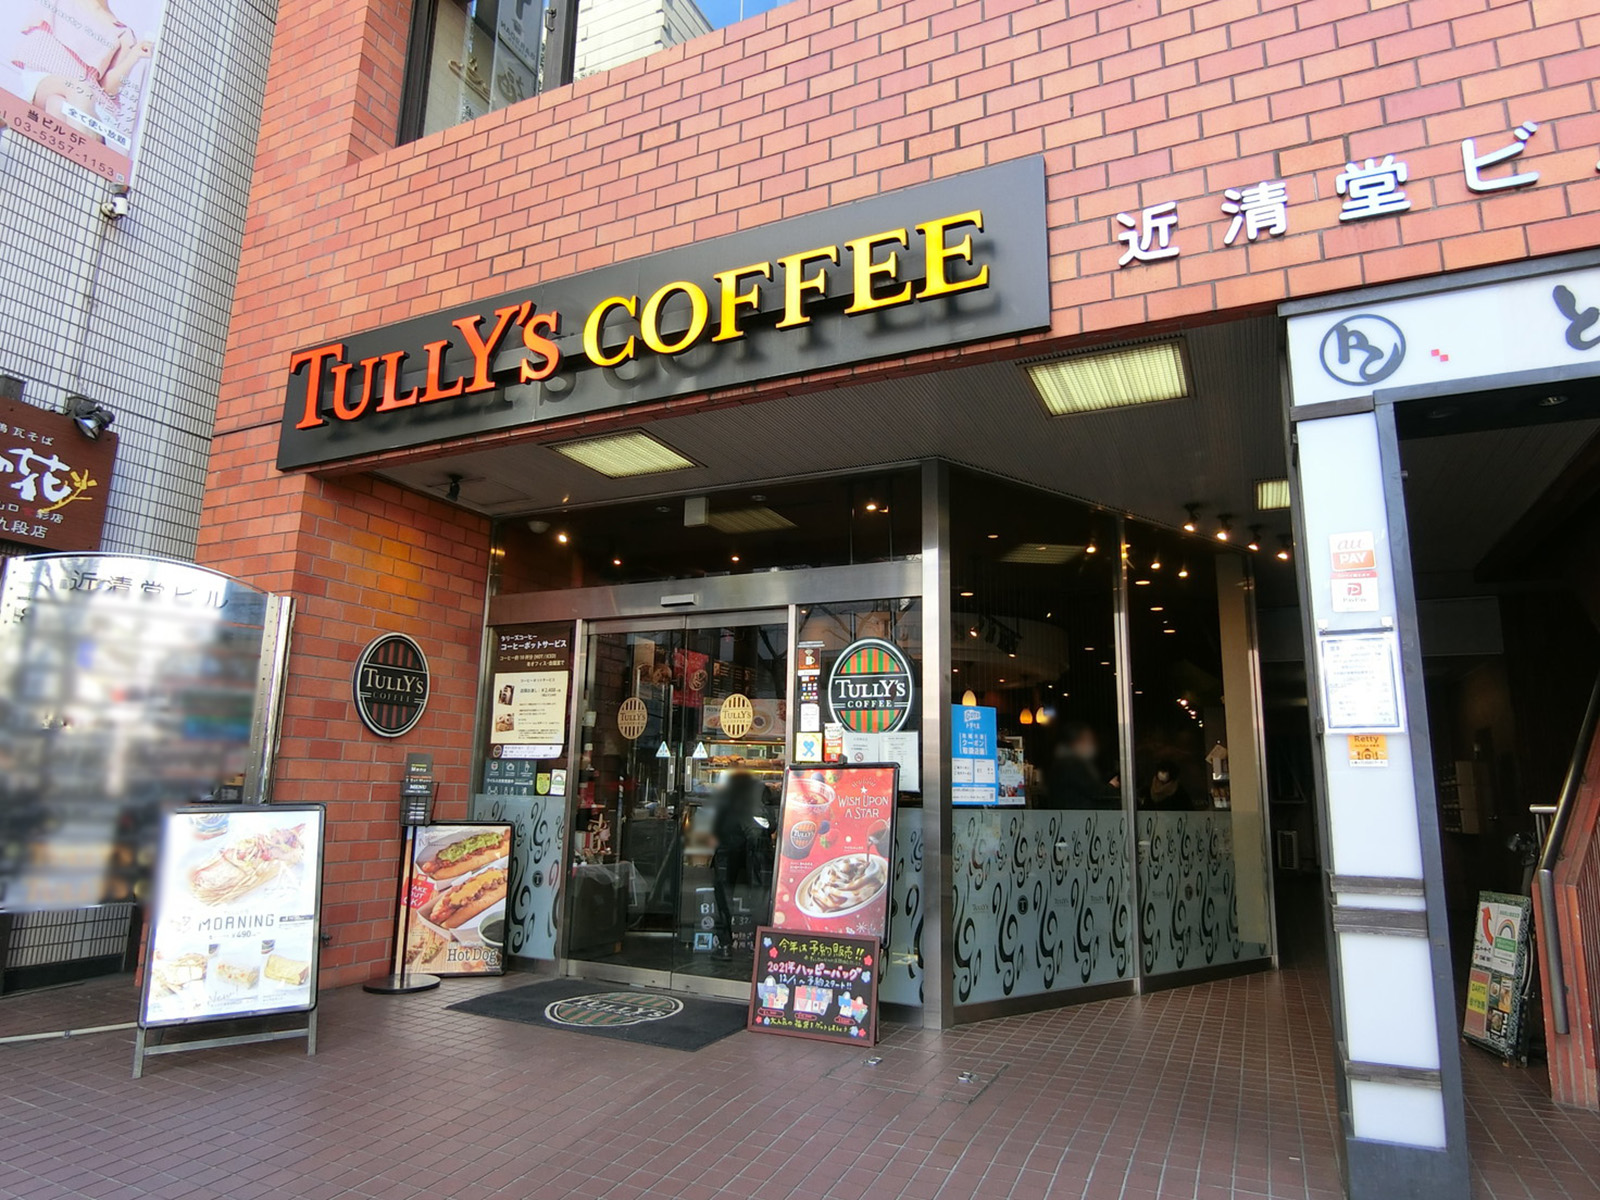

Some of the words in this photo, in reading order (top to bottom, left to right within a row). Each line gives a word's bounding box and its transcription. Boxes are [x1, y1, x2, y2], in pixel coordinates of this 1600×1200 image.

[27, 109, 66, 136] 当ビル
[70, 132, 86, 146] 5F
[68, 106, 127, 146] 全て使い放題
[14, 117, 114, 177] 03-5357-1153
[1115, 121, 1600, 267] 近清堂ビ
[290, 300, 562, 430] TULLY'S
[582, 209, 990, 367] COFFEE
[1339, 552, 1367, 565] PAY
[501, 640, 567, 651] コーヒーポットサービス
[363, 667, 424, 694] TULLY'S
[835, 678, 906, 699] TULLY'S
[847, 699, 893, 709] COFFEE
[1353, 734, 1379, 744] Retty
[837, 796, 861, 807] WISH
[862, 796, 889, 807] UPON
[854, 807, 880, 819] STAR
[198, 914, 275, 931] MORNING
[447, 948, 471, 962] Hot
[472, 949, 498, 965] Dog
[767, 961, 863, 981] 2021年ハッピーバッグ
